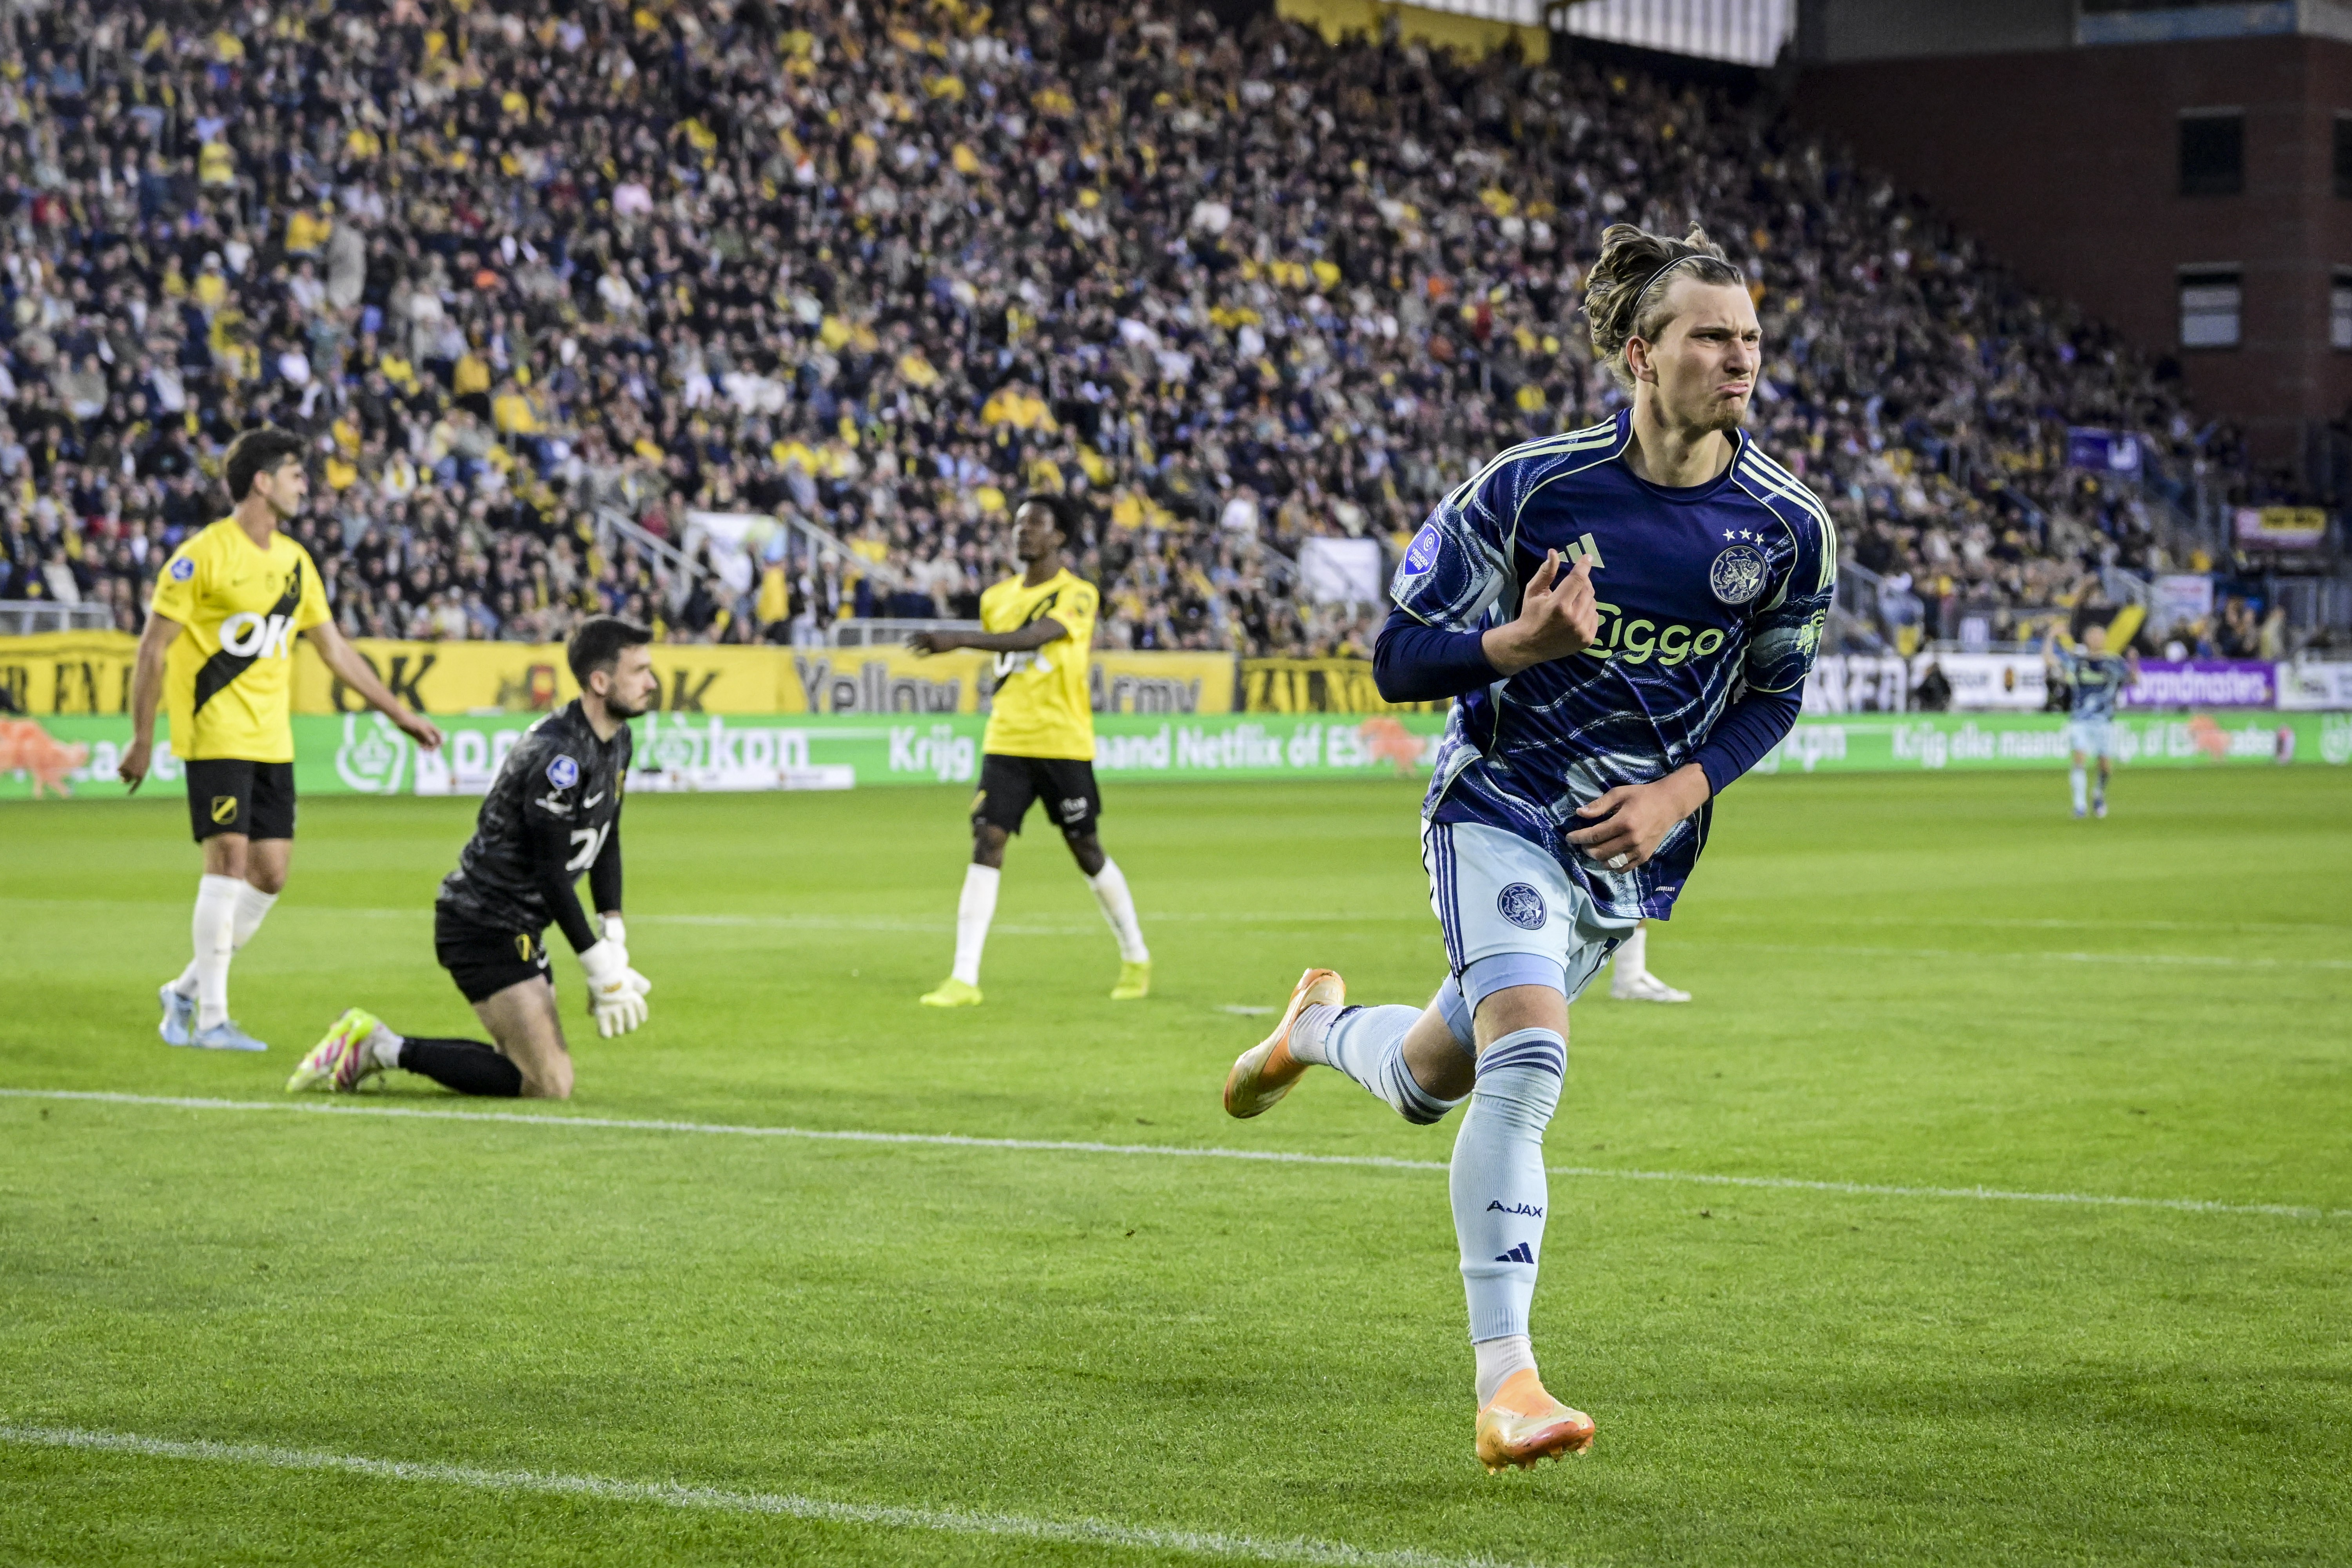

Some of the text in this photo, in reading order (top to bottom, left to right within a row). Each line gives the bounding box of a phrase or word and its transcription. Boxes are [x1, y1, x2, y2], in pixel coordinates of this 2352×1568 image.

[1408, 554, 1423, 570] LOTERIJ
[1412, 546, 1429, 567] VRIENDEN
[1713, 549, 1751, 584] AJAX
[219, 612, 295, 660] OK
[794, 655, 961, 712] Yellow
[889, 724, 975, 781] Krijg
[1094, 723, 1171, 769] aand
[1177, 722, 1282, 768] Netflix
[1486, 1200, 1543, 1218] AJAX
